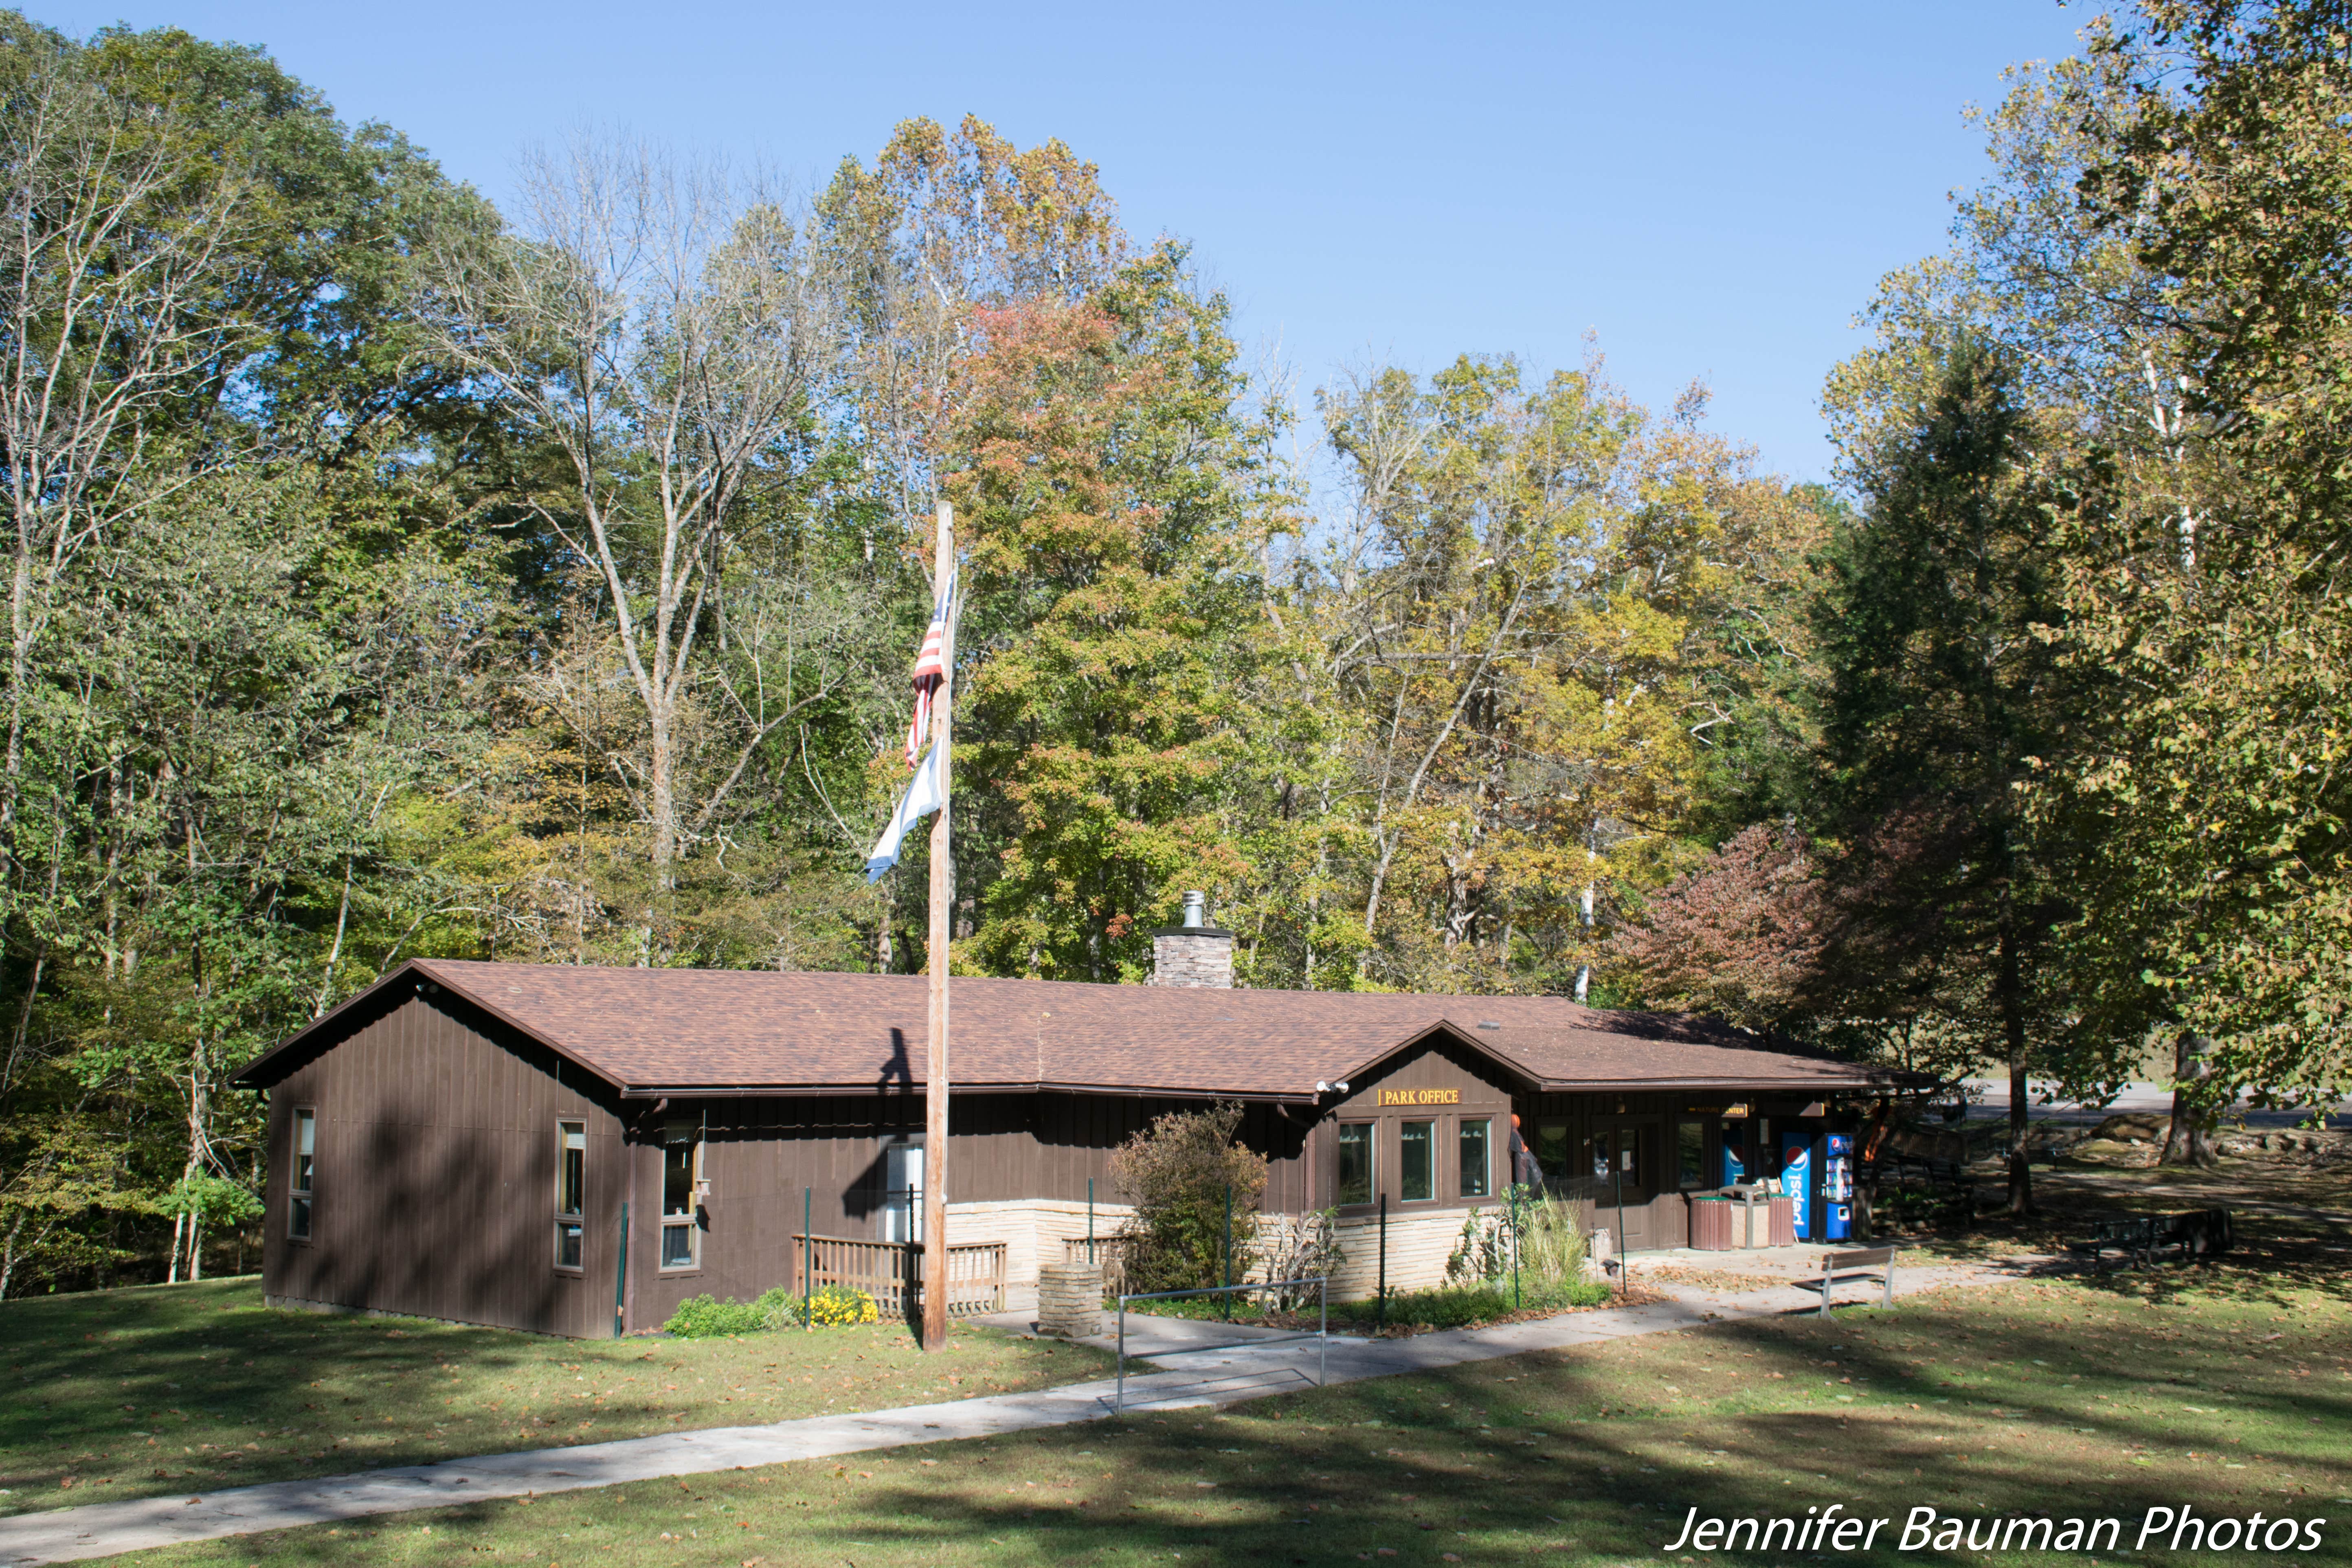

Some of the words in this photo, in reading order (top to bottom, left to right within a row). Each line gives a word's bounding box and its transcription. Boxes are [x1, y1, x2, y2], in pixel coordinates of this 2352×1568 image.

[1386, 1091, 1416, 1104] PARK
[1419, 1090, 1458, 1103] OFFICE
[1788, 1174, 1805, 1225] pepsi
